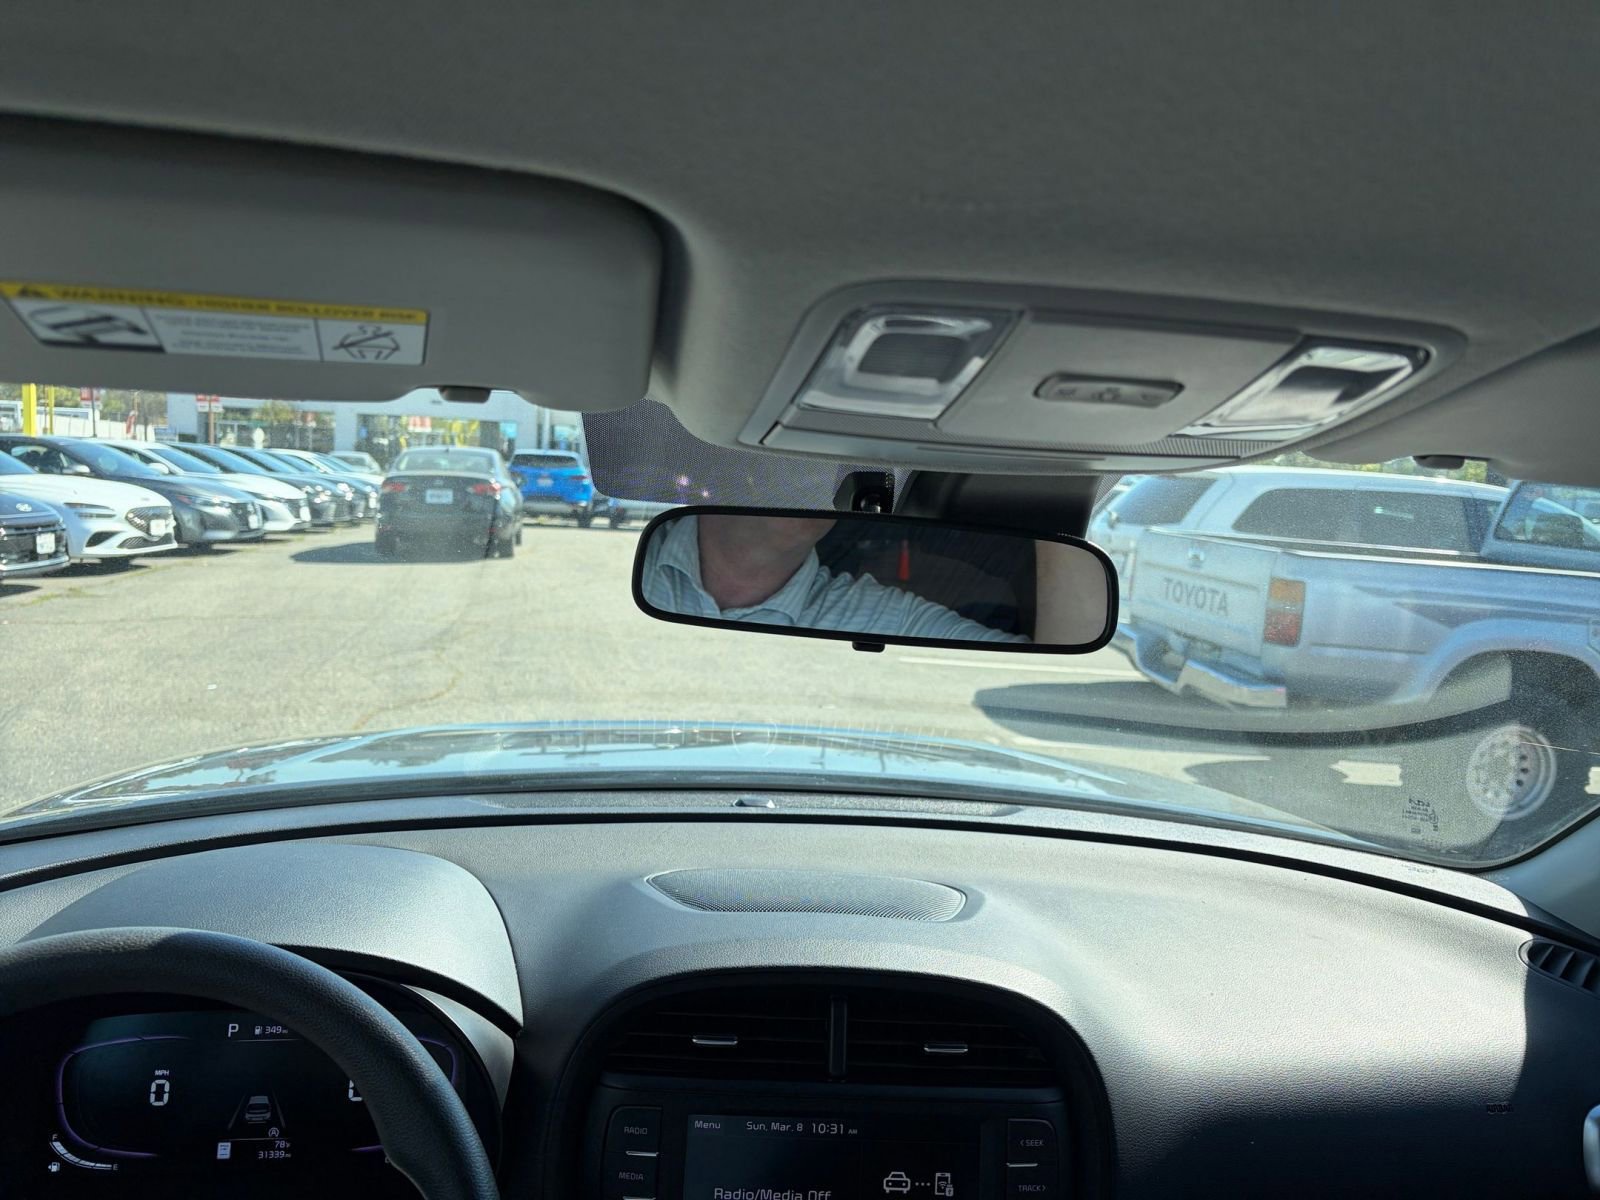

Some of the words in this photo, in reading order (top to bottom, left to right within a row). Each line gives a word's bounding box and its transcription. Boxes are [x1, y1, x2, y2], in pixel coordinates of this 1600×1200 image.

[1163, 577, 1228, 617] TOYOTA
[227, 1023, 239, 1038] P
[265, 1025, 282, 1034] 349
[149, 1079, 170, 1106] 0
[623, 1126, 648, 1135] RADIO
[694, 1120, 721, 1129] Menu
[771, 1122, 794, 1131] Mar.
[796, 1122, 804, 1132] 8
[812, 1123, 844, 1134] 10:31
[1025, 1139, 1045, 1147] SEEK
[257, 1150, 285, 1159] 31339
[618, 1171, 644, 1180] MEDIA
[714, 1187, 803, 1200] Radio/Media
[808, 1190, 832, 1200] Off
[1018, 1184, 1041, 1193] TRACK
